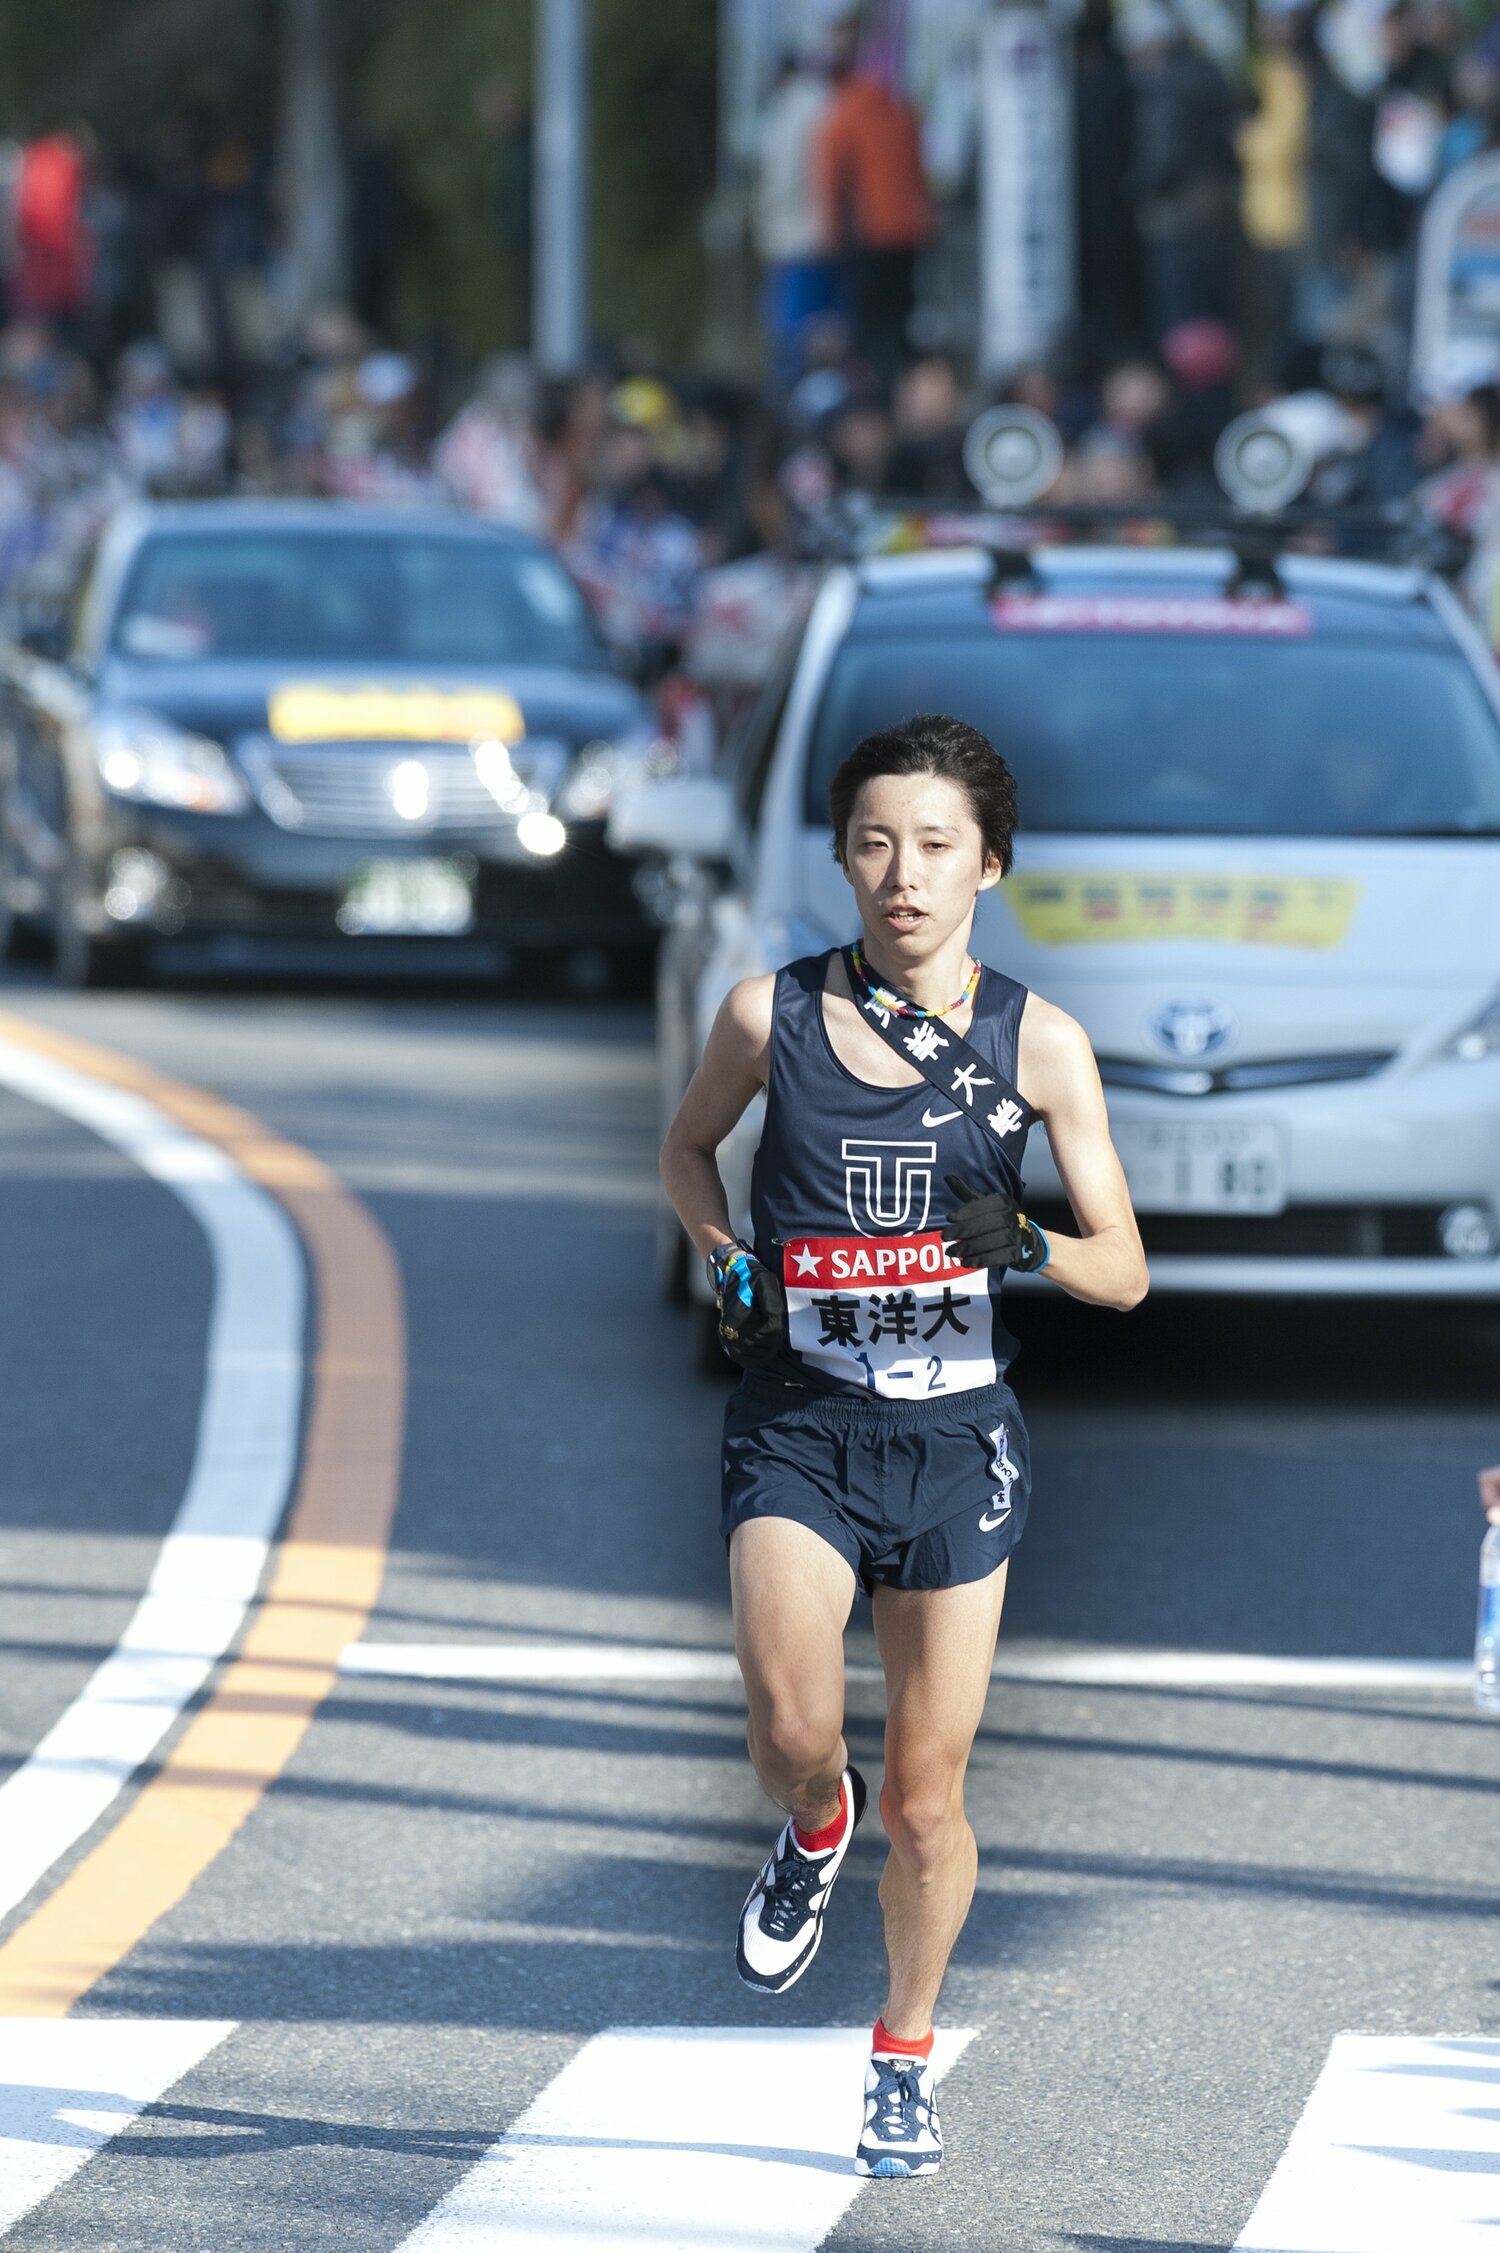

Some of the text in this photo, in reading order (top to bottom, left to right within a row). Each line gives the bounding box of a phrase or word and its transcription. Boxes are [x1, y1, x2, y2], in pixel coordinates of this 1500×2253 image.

[831, 1240, 961, 1279] SAPPOR
[811, 1287, 971, 1348] 東洋大
